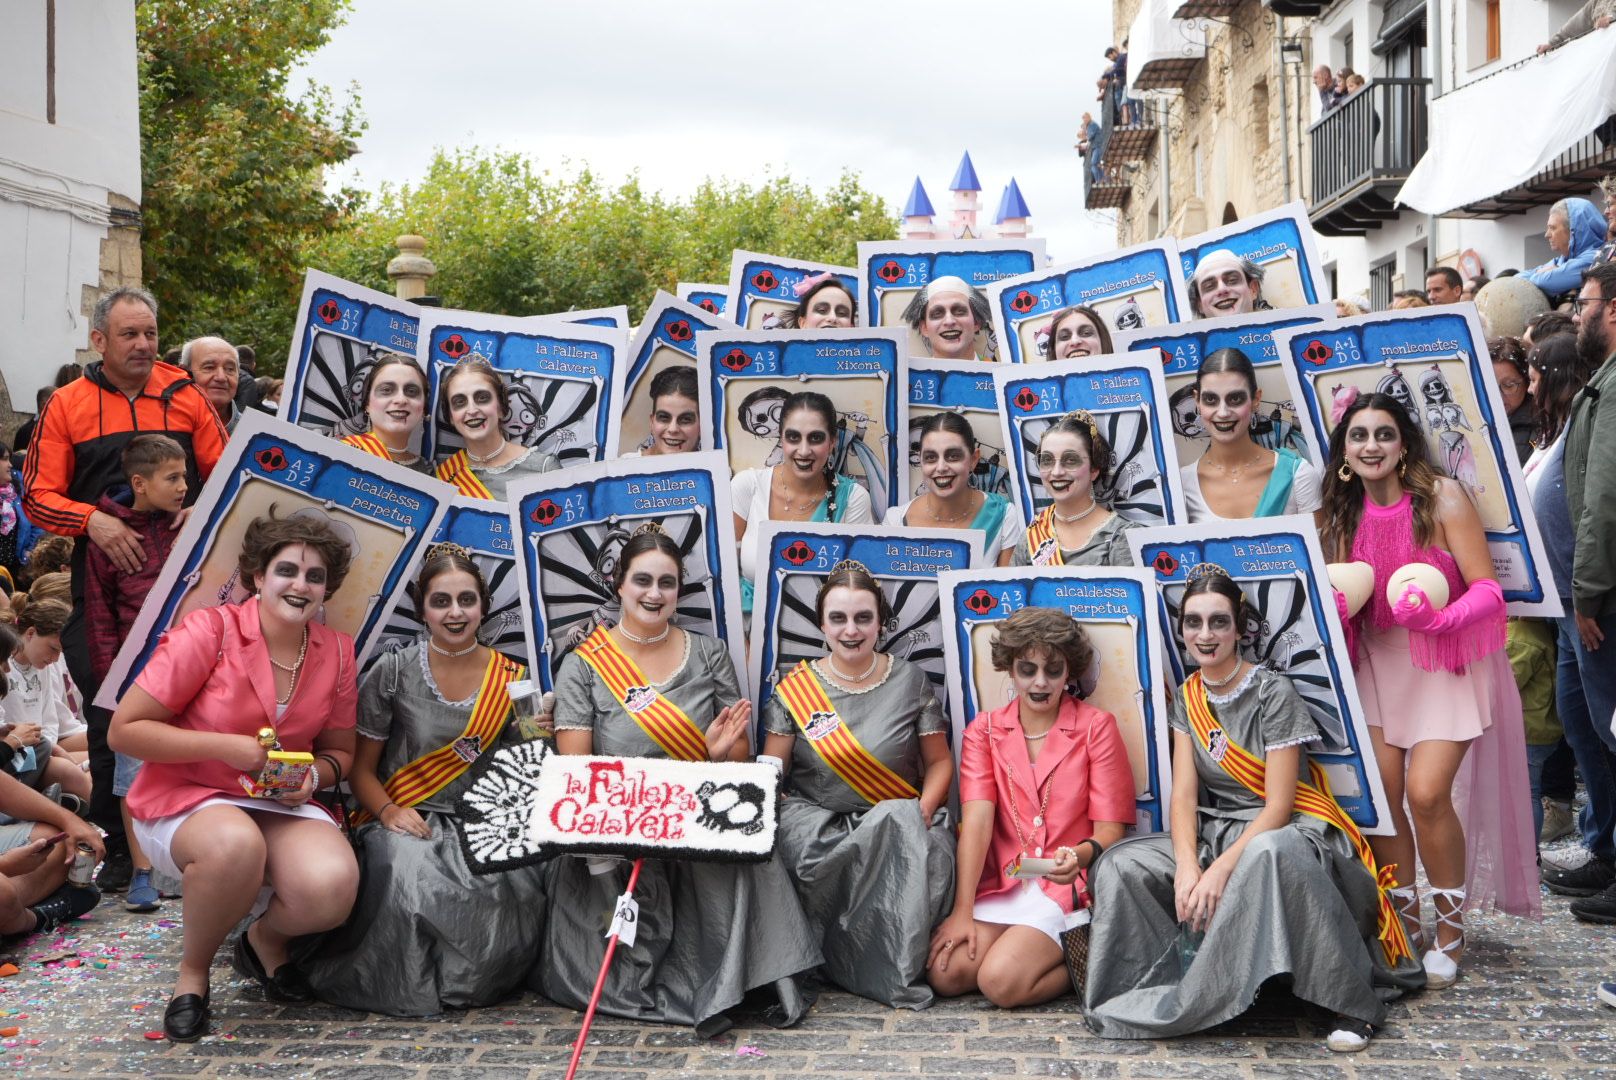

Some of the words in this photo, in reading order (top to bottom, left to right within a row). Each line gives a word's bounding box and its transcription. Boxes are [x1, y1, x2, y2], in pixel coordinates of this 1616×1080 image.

[908, 263, 915, 272] A
[919, 262, 926, 272] 2
[908, 273, 917, 284] D
[920, 273, 927, 283] 2
[780, 286, 789, 297] D
[1042, 298, 1051, 310] D
[343, 308, 351, 320] A
[353, 310, 360, 320] 7
[341, 320, 350, 331] D
[351, 322, 358, 332] 7
[401, 322, 420, 336] Fall
[390, 334, 418, 351] Calav
[473, 340, 481, 350] A
[486, 341, 492, 351] 7
[1239, 333, 1271, 345] xico
[536, 342, 547, 355] la
[815, 346, 861, 358] xicona
[865, 345, 881, 356] de
[1175, 346, 1184, 357] A
[1188, 343, 1196, 355] 3
[1381, 337, 1459, 355] monleonetes
[755, 352, 763, 361] A
[768, 350, 775, 361] 3
[1336, 352, 1348, 364] D
[539, 359, 597, 375] Calavera
[755, 362, 765, 373] D
[769, 362, 776, 372] 3
[1176, 357, 1187, 369] D
[1191, 356, 1199, 366] 3
[914, 379, 923, 389] A
[927, 379, 935, 390] 3
[975, 380, 996, 391] xic
[1090, 379, 1101, 390] la
[914, 389, 924, 401] D
[928, 391, 935, 401] 3
[1041, 388, 1049, 400] A
[1051, 386, 1056, 397] 7
[1096, 392, 1142, 405] Calavera
[1043, 400, 1051, 411] D
[1053, 398, 1059, 409] 7
[290, 459, 302, 471] A
[305, 462, 315, 474] 3
[285, 469, 298, 482] D
[299, 476, 311, 487] 2
[627, 482, 641, 495] la
[645, 479, 696, 493] Fallera
[348, 477, 420, 511] alcaldessa
[565, 497, 574, 509] A
[575, 494, 582, 506] 7
[634, 495, 697, 510] Calavera
[565, 510, 575, 522] D
[578, 506, 584, 518] 7
[818, 545, 828, 556] A
[832, 545, 840, 556] 7
[886, 544, 899, 556] la
[904, 545, 953, 558] Fallera
[1232, 544, 1246, 557] la
[1248, 542, 1293, 556] Fallera
[817, 556, 828, 568] D
[1180, 553, 1188, 564] A
[1189, 551, 1195, 563] 7
[890, 559, 952, 573] Calavera
[1241, 559, 1297, 573] Calavera
[1001, 591, 1010, 602] A
[1013, 590, 1022, 601] 3
[1055, 585, 1128, 598] alcaldessa
[563, 772, 587, 795] la
